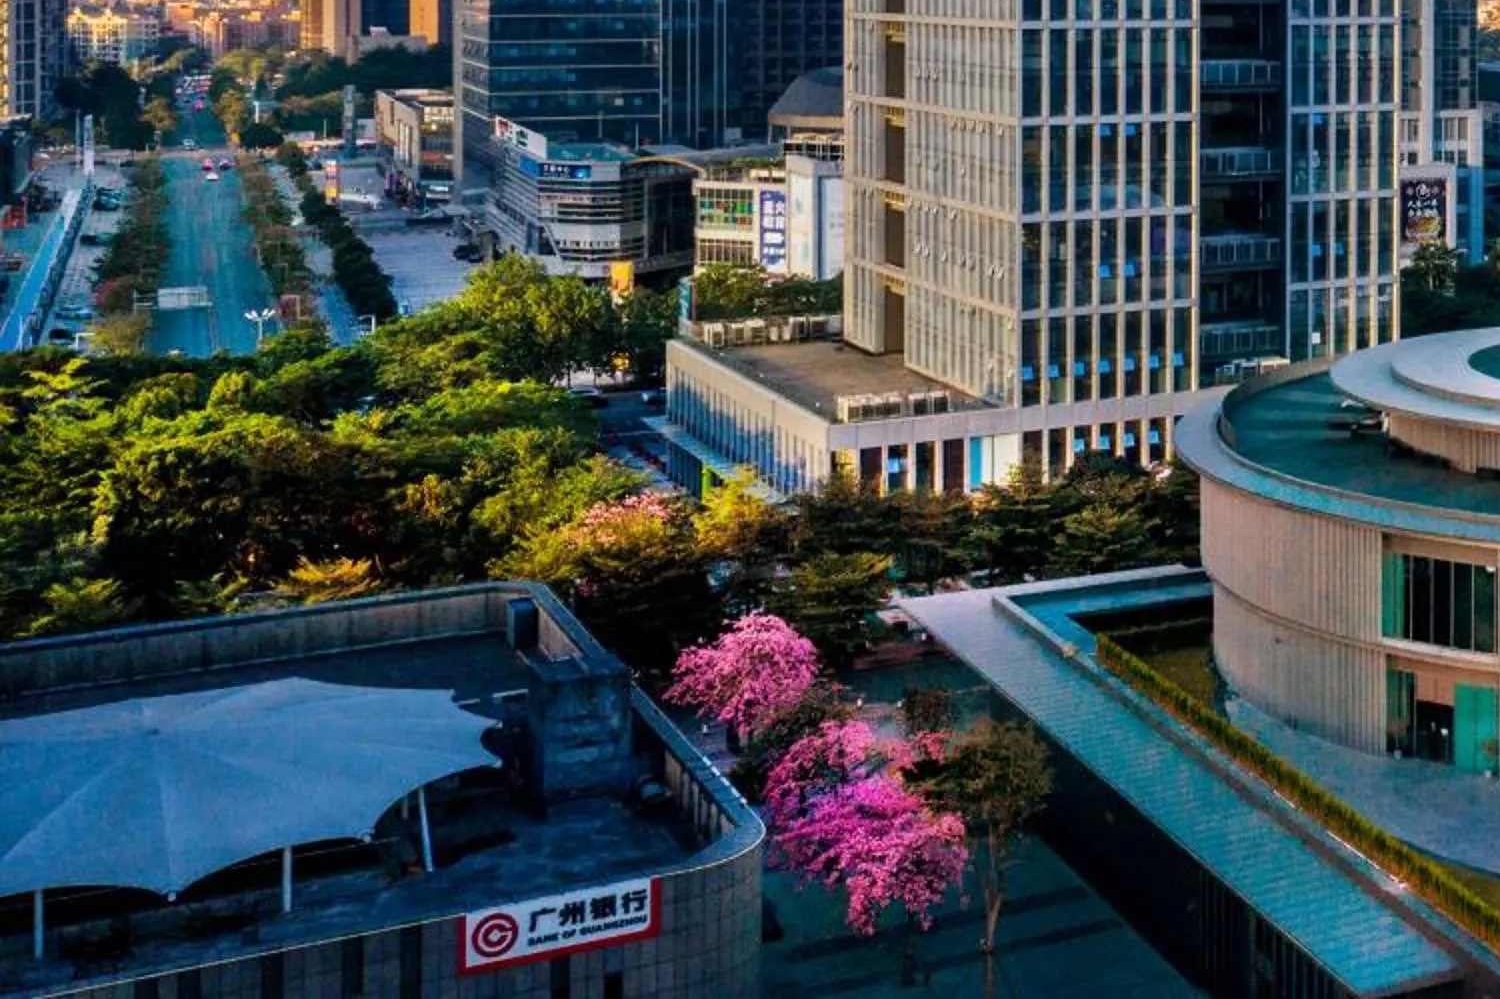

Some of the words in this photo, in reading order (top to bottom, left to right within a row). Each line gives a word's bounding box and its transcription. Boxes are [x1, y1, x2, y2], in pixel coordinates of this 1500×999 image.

[529, 888, 648, 932] 广州银行
[528, 932, 559, 946] BANK
[562, 928, 577, 939] OF
[580, 914, 648, 936] GUANGZHOU
